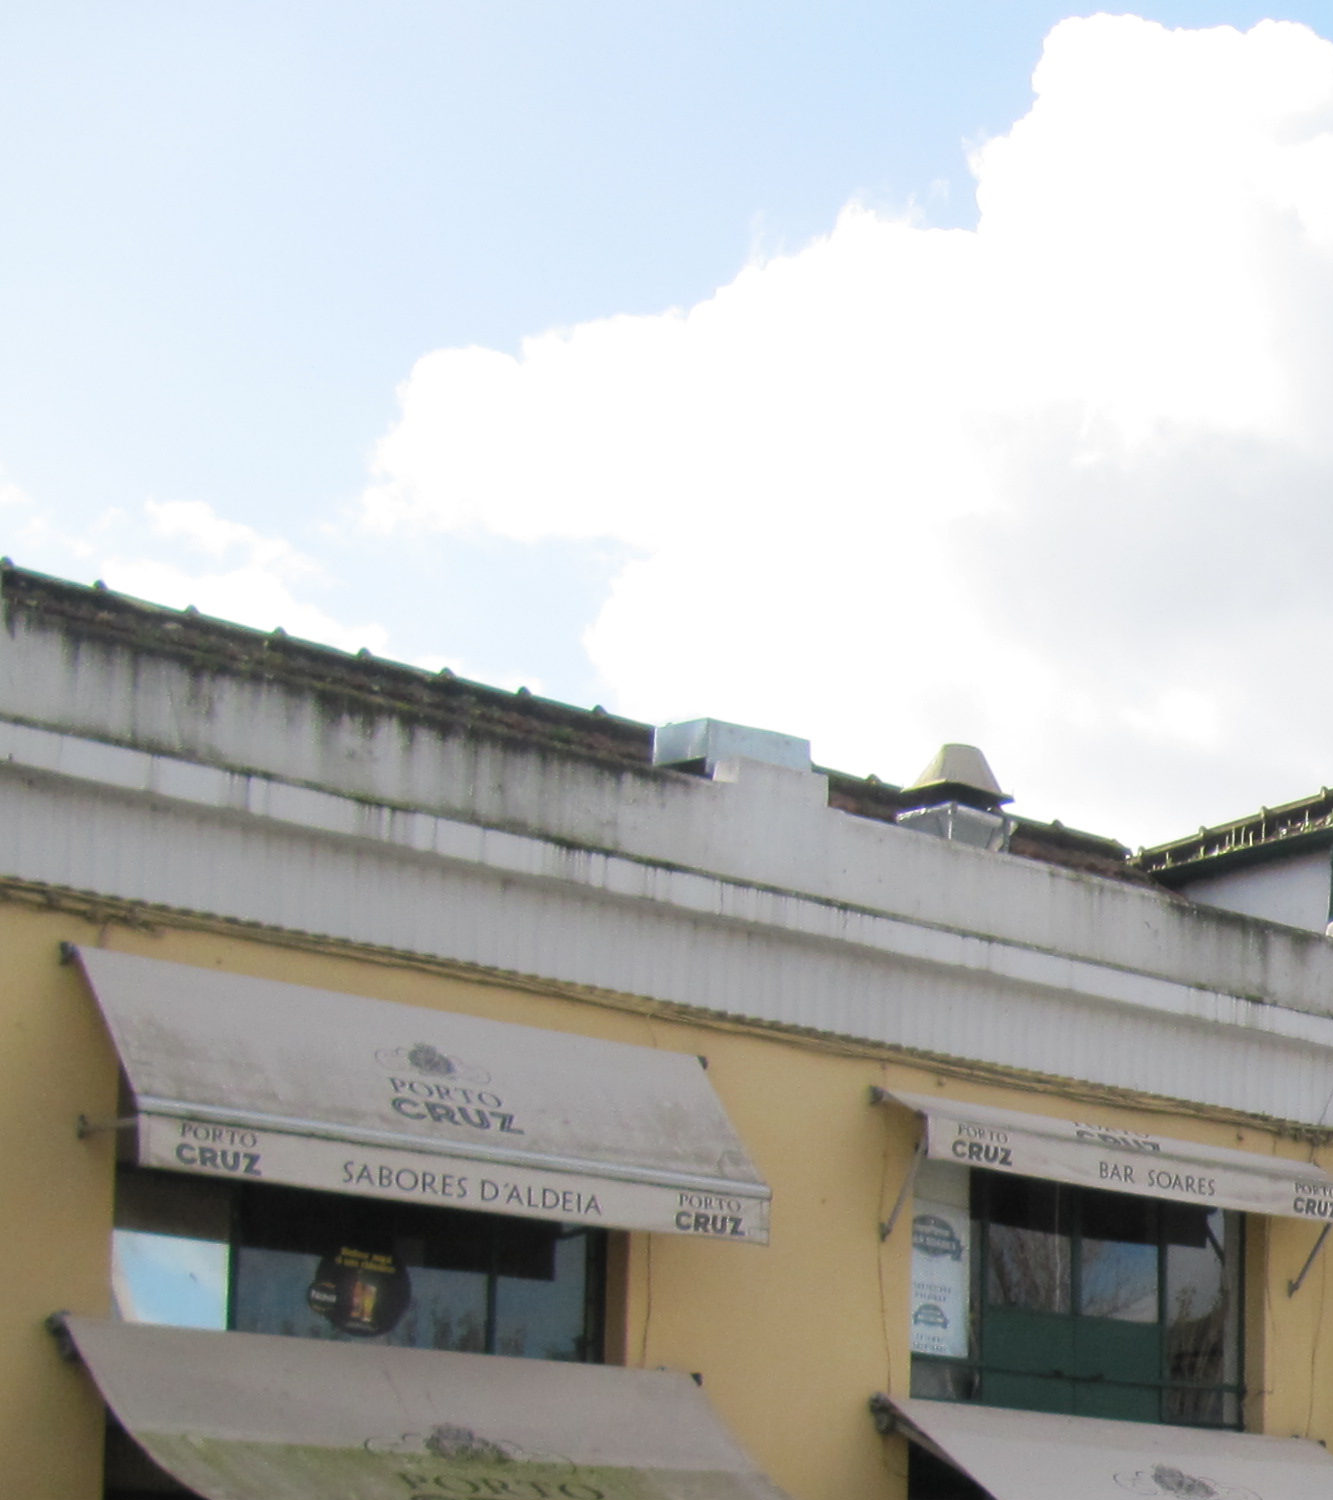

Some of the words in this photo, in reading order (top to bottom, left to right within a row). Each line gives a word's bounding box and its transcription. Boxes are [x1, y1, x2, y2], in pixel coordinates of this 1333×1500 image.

[389, 1077, 504, 1108] PORTO
[391, 1096, 526, 1135] CRUZ
[179, 1121, 258, 1148] PORTO
[957, 1123, 1008, 1144] PORTO
[174, 1142, 262, 1177] CRUZ
[951, 1138, 1014, 1167] CRUZ
[341, 1160, 468, 1198] SABORES
[479, 1180, 602, 1216] D'ALDEIA
[1099, 1160, 1137, 1185] BAR
[1147, 1168, 1217, 1197] SOARES
[678, 1193, 743, 1212] PORTO
[674, 1210, 747, 1237] CRUZ
[398, 1470, 605, 1500] PORTO
